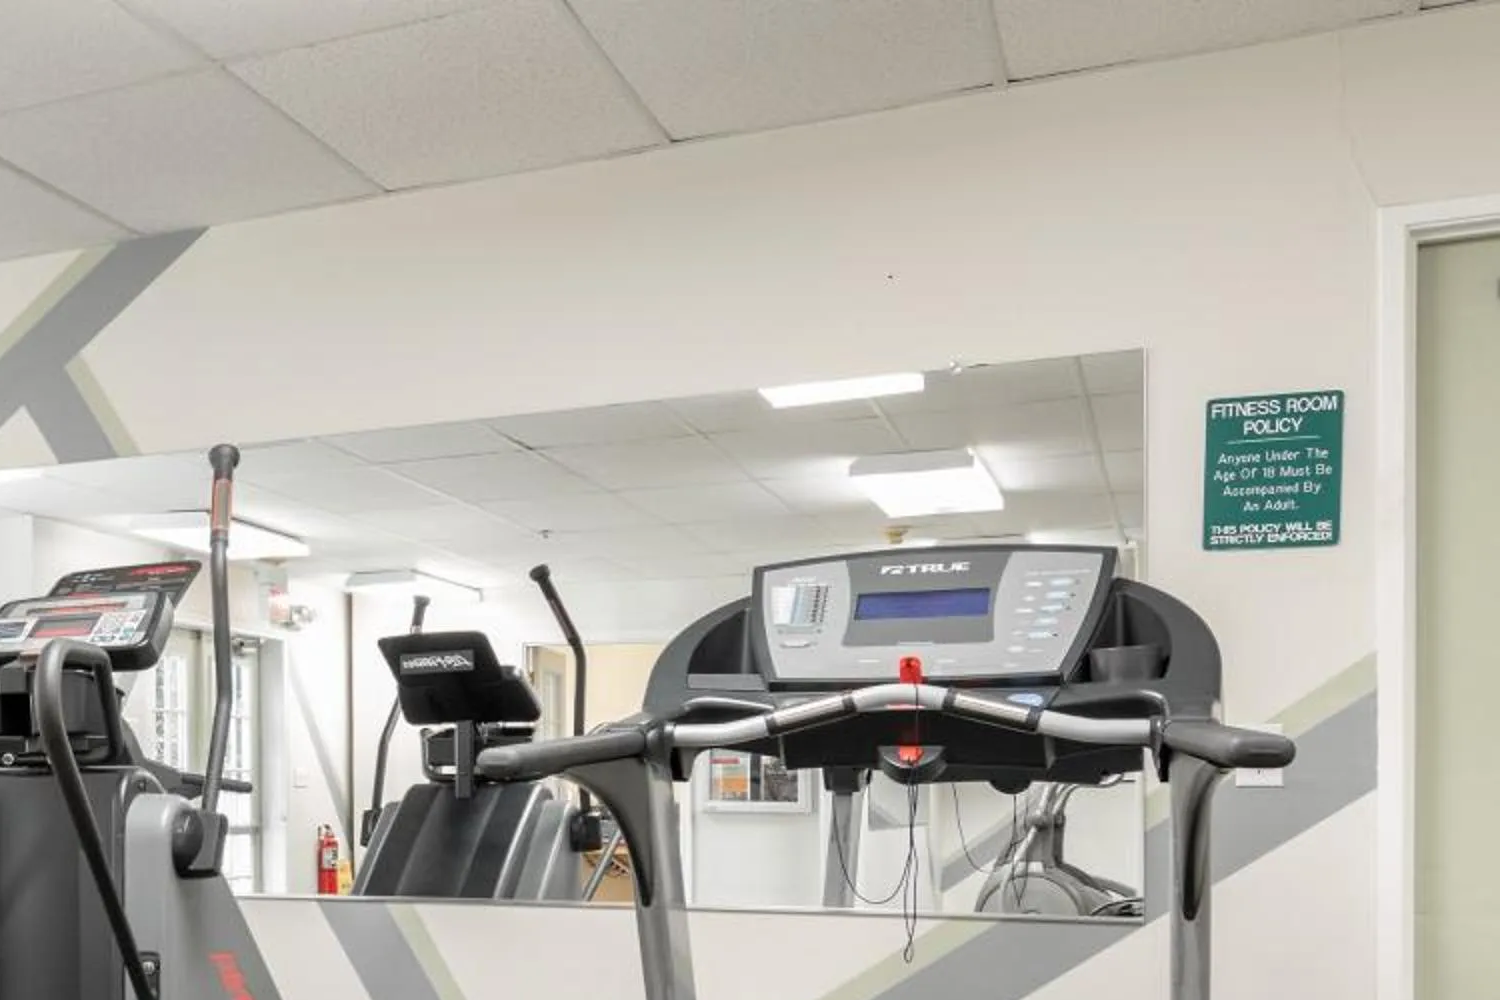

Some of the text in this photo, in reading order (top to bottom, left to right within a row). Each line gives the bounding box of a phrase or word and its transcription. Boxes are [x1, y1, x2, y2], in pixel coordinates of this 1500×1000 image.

[1211, 396, 1337, 419] FITNESS ROOM
[1243, 417, 1303, 435] POLICY
[1218, 447, 1329, 465] Anyone Under The
[1213, 463, 1332, 482] Age Of 18 Must Be
[1223, 481, 1321, 497] Accompanied By
[1243, 501, 1260, 512] An
[1210, 525, 1237, 535] THIS
[1240, 523, 1281, 533] POLICY
[1285, 521, 1313, 531] WILL
[1210, 534, 1264, 545] STRICTLY
[904, 561, 971, 574] TRUE
